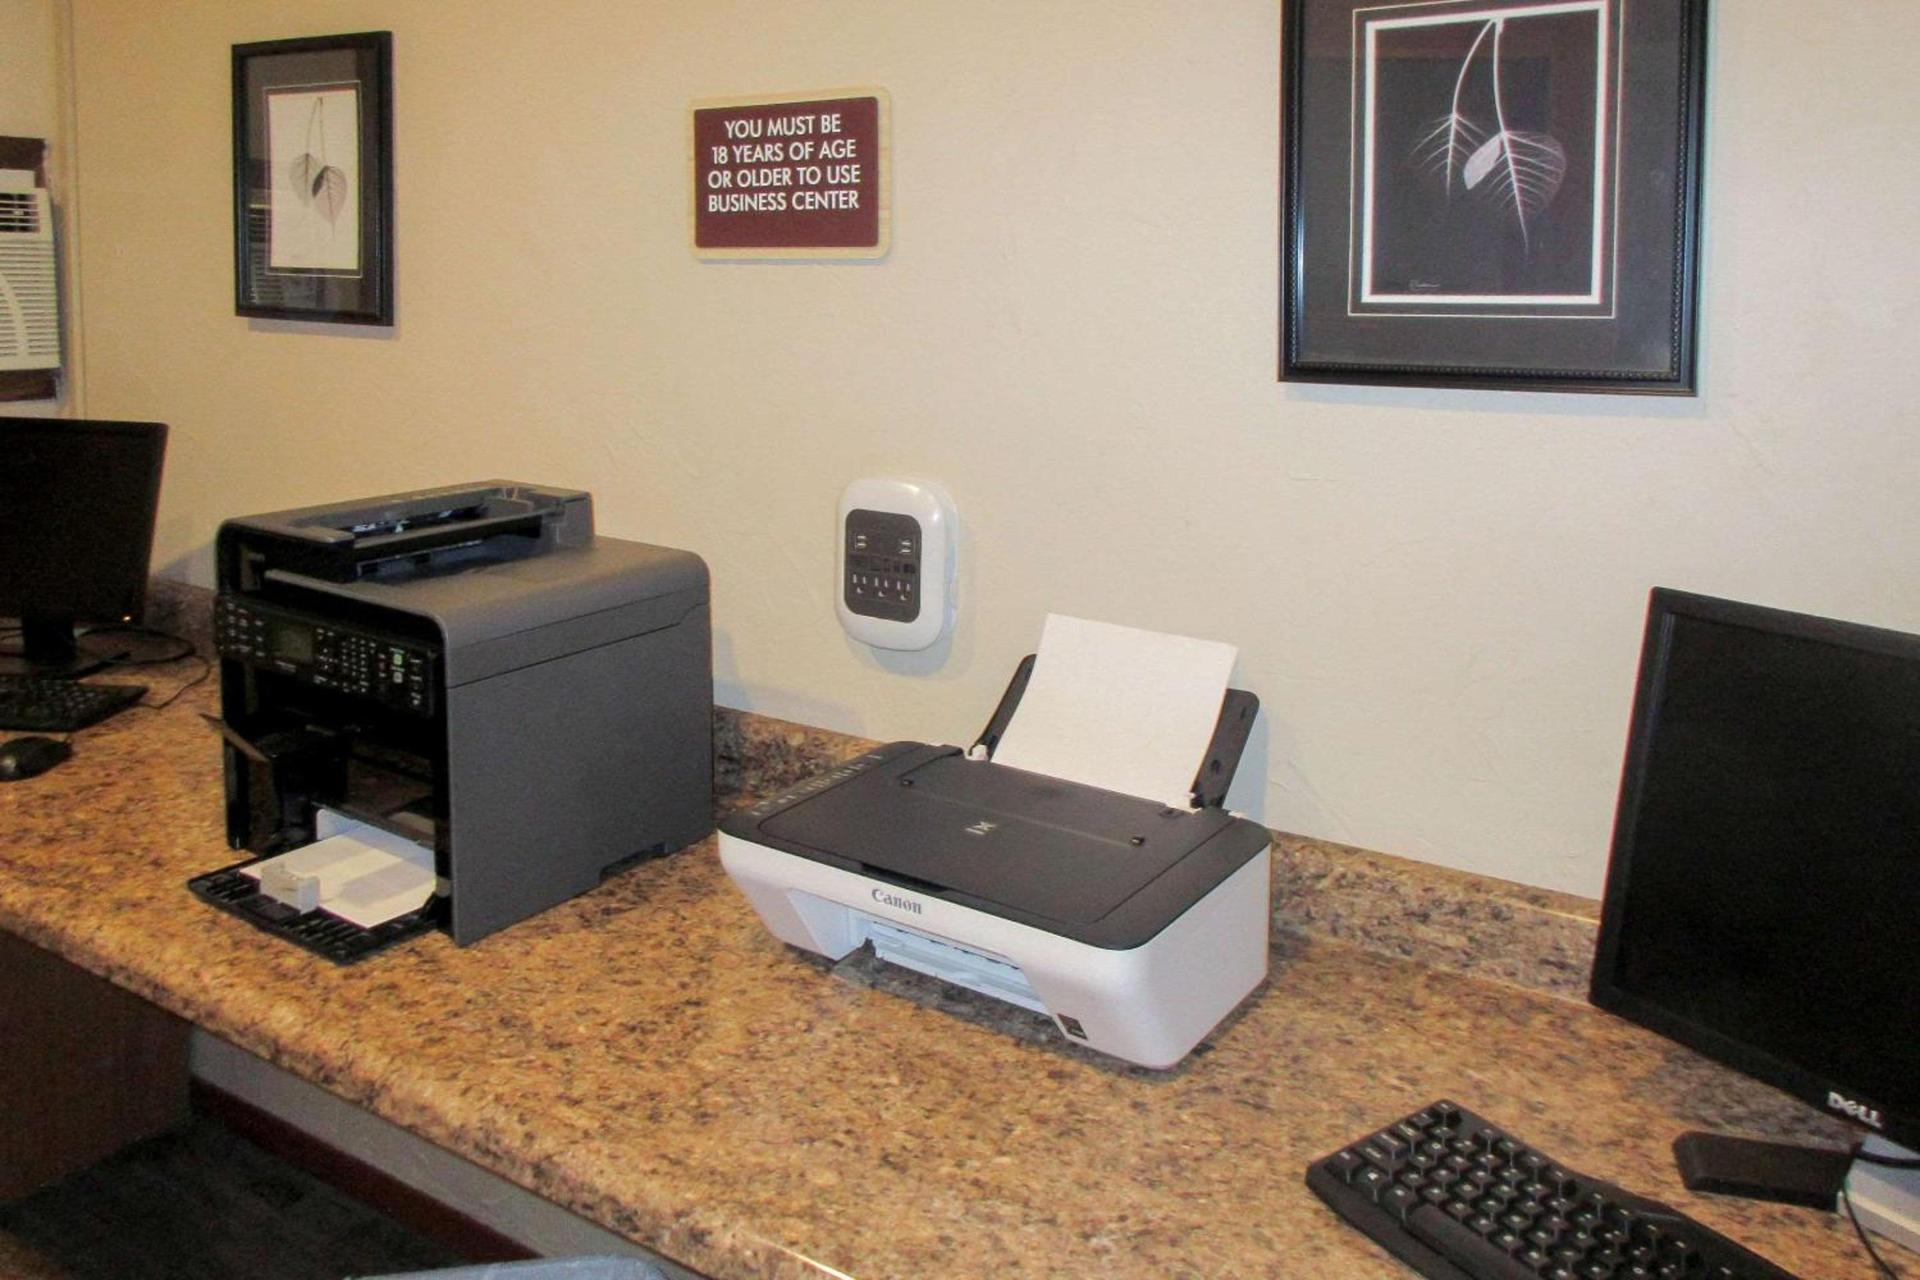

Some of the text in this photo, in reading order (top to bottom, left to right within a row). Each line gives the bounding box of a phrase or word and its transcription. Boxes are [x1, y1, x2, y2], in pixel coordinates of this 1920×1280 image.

[724, 114, 841, 139] YOU MUST BE
[712, 139, 856, 164] 18 YEARS OF AGE
[708, 164, 861, 189] OR OLDER TO USE
[708, 190, 859, 213] BUSINESS CENTER
[871, 888, 922, 915] Canon
